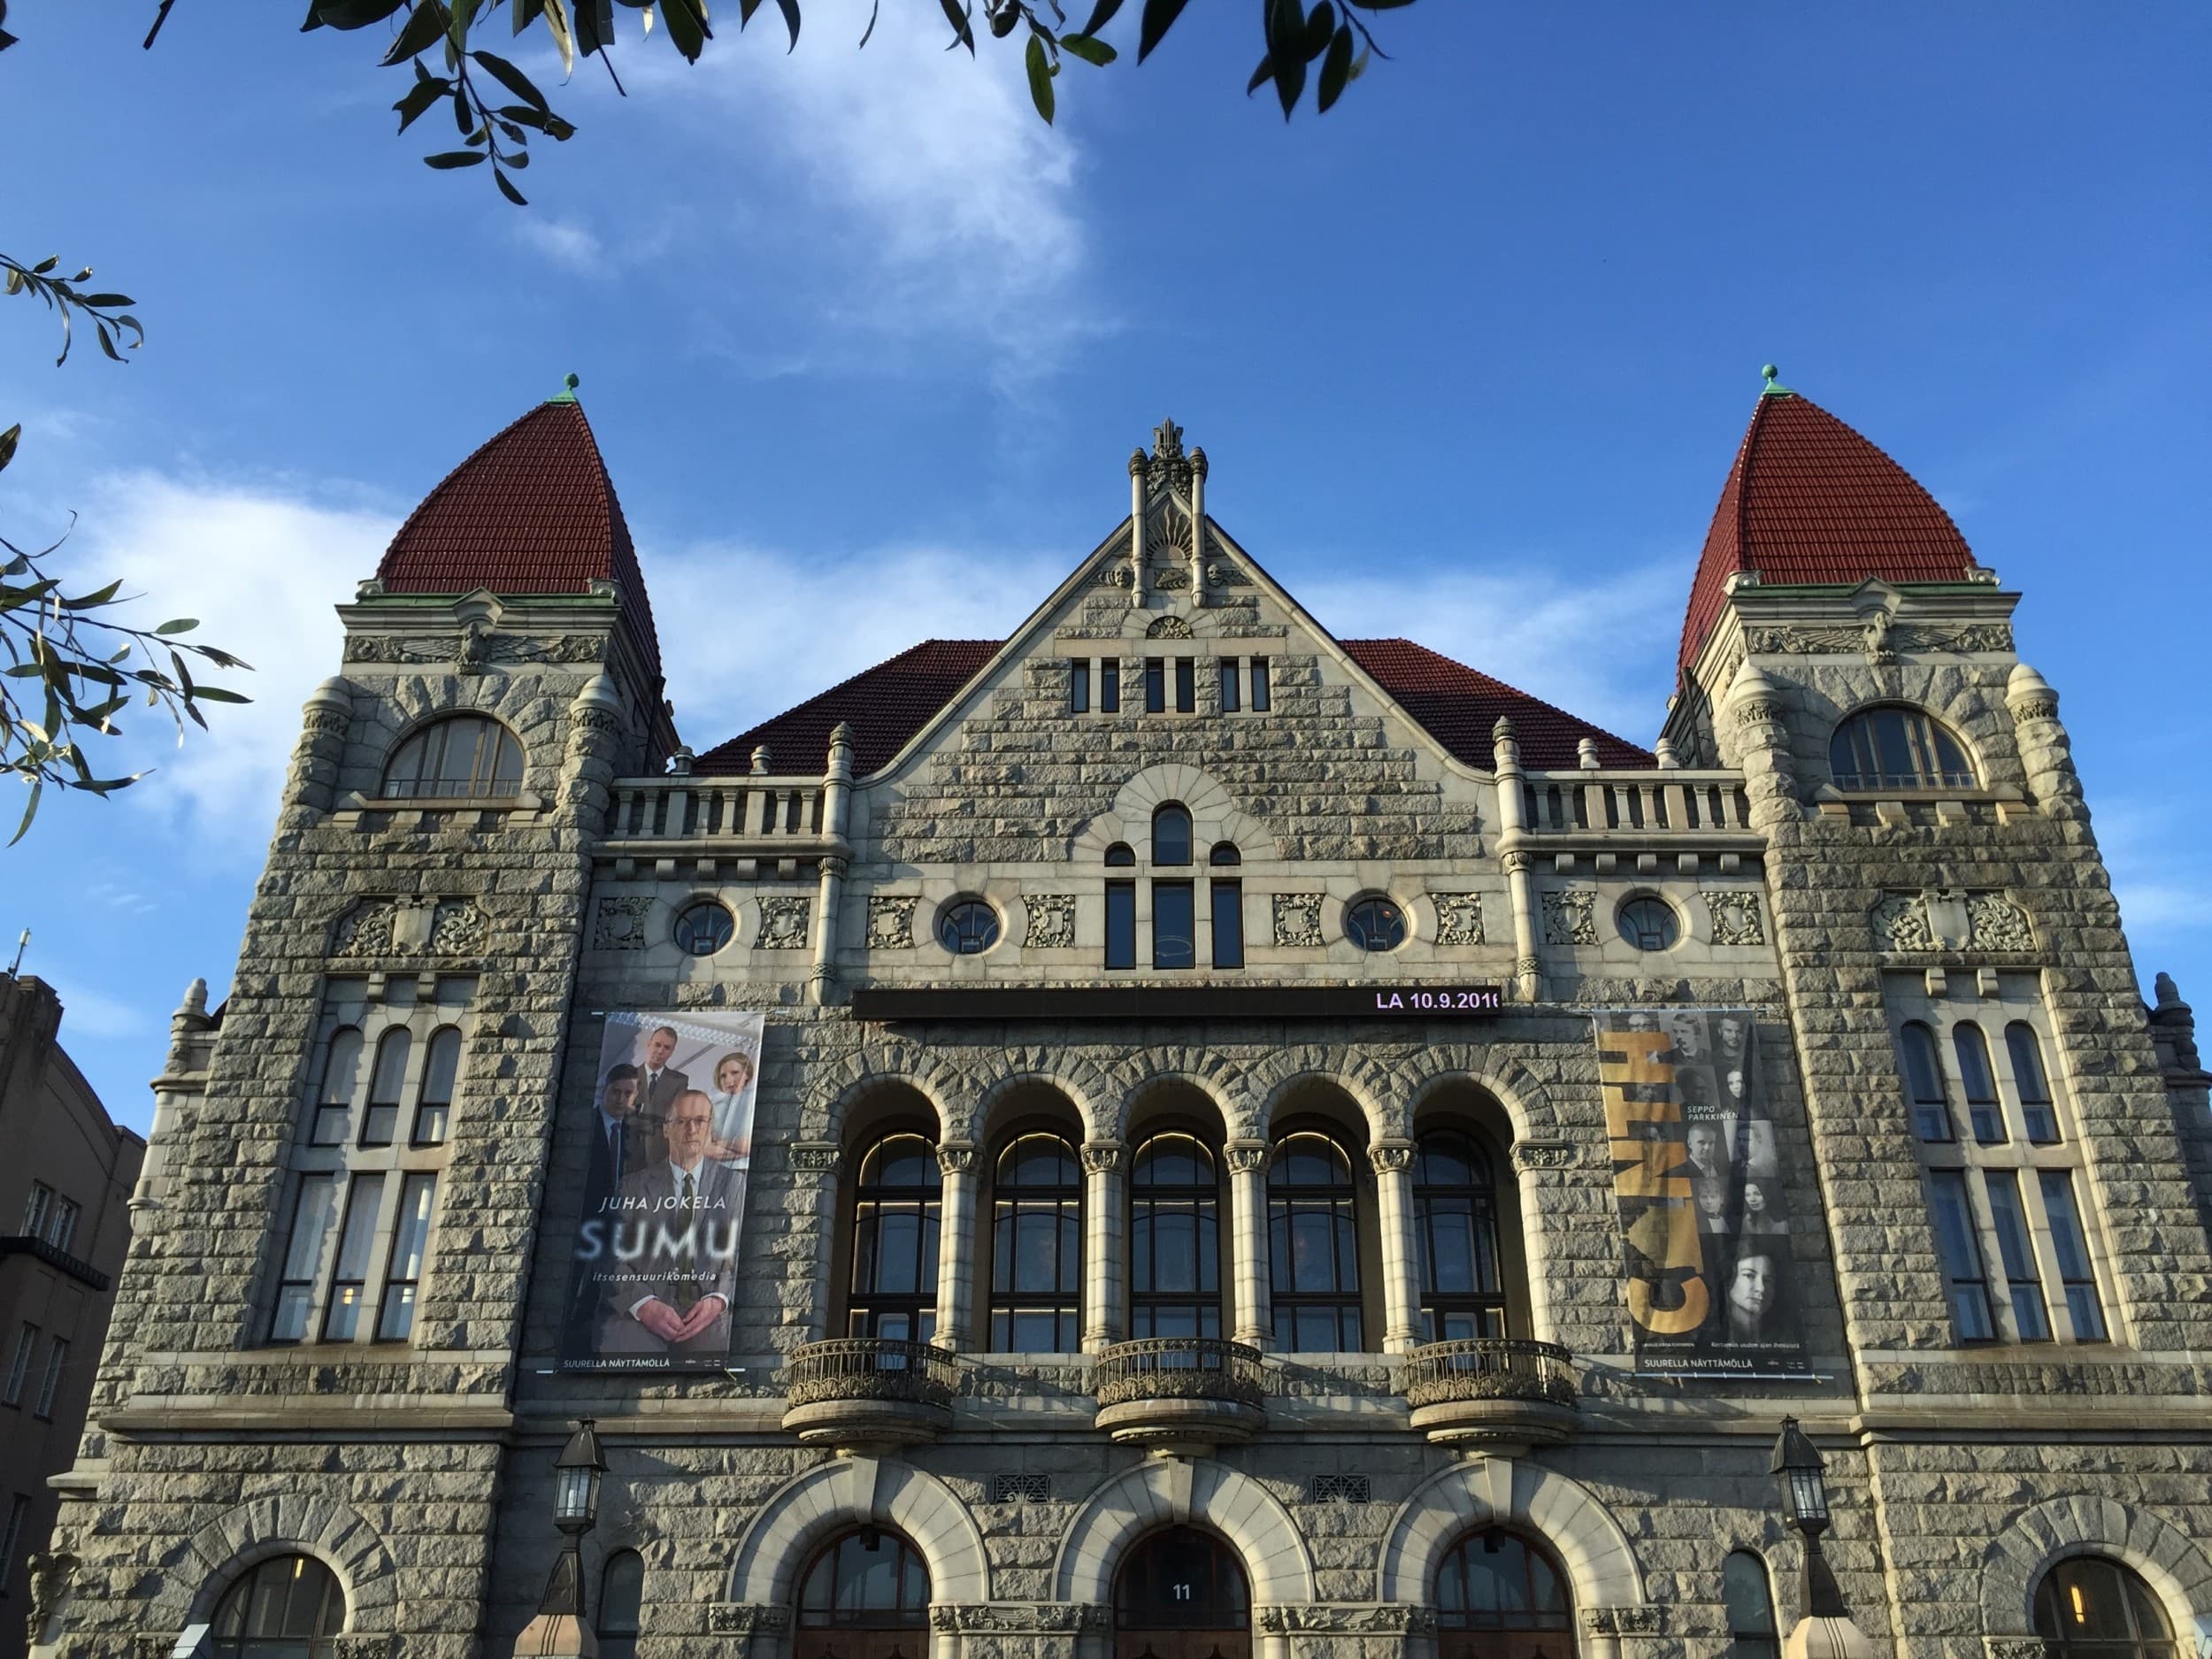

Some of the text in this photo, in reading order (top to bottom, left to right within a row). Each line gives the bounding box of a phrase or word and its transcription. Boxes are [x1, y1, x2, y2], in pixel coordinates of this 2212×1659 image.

[1376, 993, 1404, 1009] LA
[1687, 1111, 1739, 1121] PARKKINEN
[1598, 1031, 1709, 1334] CANTH
[598, 1195, 726, 1213] JUHA JOKELA
[576, 1218, 741, 1261] SUMU
[592, 1271, 717, 1282] itsesensuurikomedia
[564, 1358, 671, 1368] SUURELLA NÄYTTÄMÖLLÄ
[1644, 1358, 1754, 1368] SUURELLA NÄYTTÄMÖLLÄ
[1173, 1584, 1190, 1600] 11
